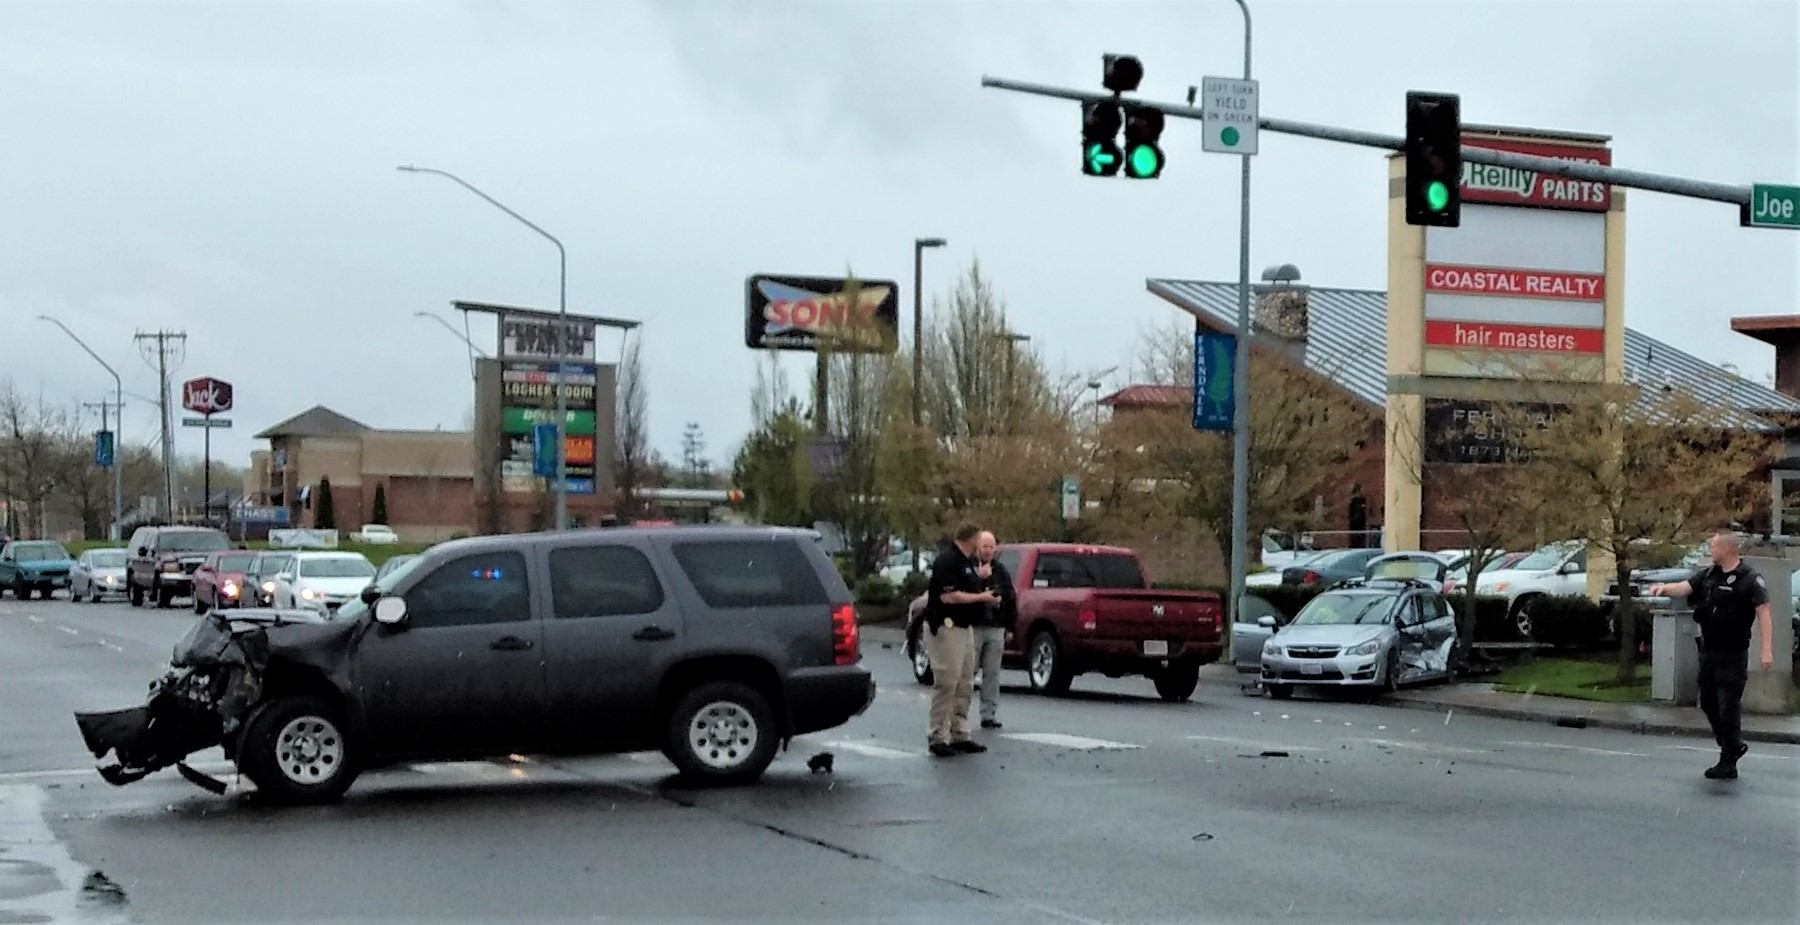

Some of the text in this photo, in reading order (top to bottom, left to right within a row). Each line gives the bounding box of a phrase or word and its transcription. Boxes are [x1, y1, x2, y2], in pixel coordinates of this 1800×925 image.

[1215, 97, 1247, 110] YIELD
[1460, 161, 1537, 196] Reilly
[1542, 178, 1605, 203] PARTS
[1756, 191, 1794, 219] Joe
[1431, 270, 1599, 296] COASTAL REALTY
[772, 298, 877, 328] SONIC
[1455, 324, 1575, 350] hair masters
[1197, 335, 1207, 416] FERNDALE
[184, 380, 231, 411] Jack
[557, 384, 593, 399] OOM
[523, 409, 577, 422] DOLLR
[1461, 444, 1500, 456] 1873
